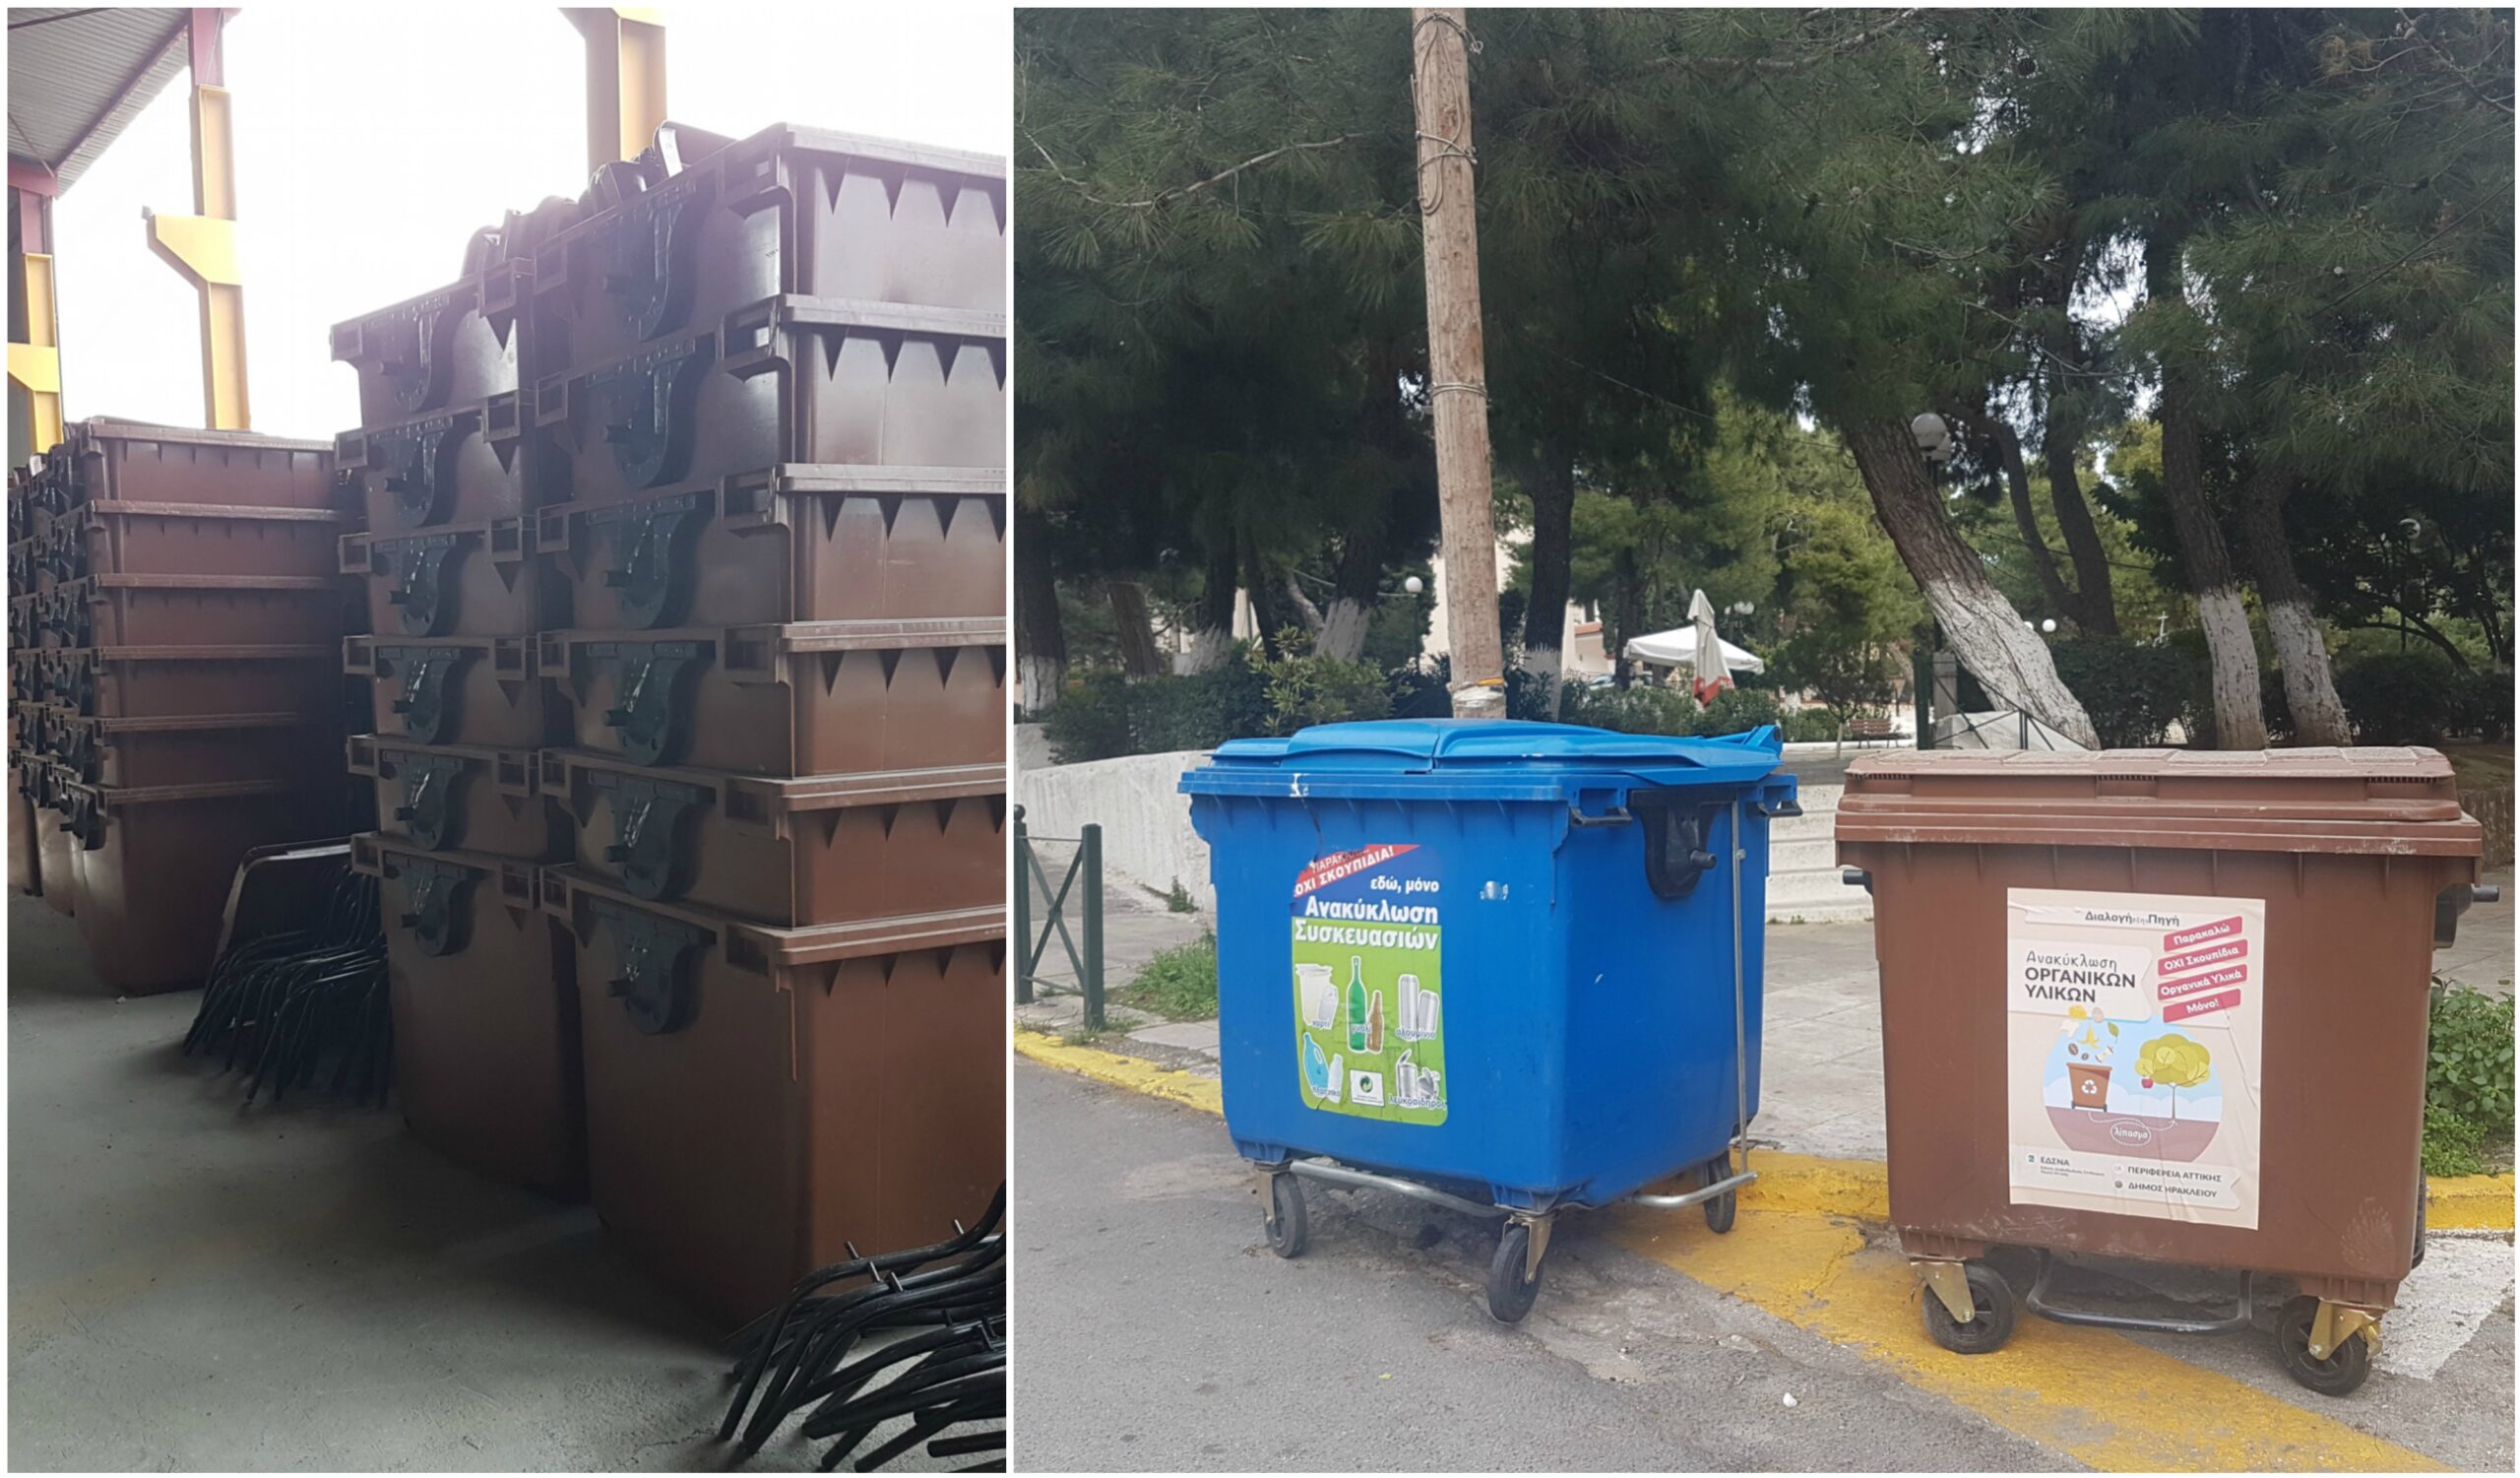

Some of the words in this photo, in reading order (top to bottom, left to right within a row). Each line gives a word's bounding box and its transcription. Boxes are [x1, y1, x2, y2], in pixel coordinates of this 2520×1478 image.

[1294, 877, 1316, 896] ΟΧΙ
[1319, 845, 1395, 885] ΣΚΟΥΠΙΔΙΑ!
[1370, 875, 1402, 893] εδώ,
[1406, 876, 1439, 894] μόνο
[1305, 895, 1438, 924] Ανακύκλωση
[2085, 910, 2132, 925] Διαλογή
[2148, 913, 2179, 927] Πηγή
[1294, 919, 1439, 950] Συσκευασιών
[2173, 923, 2231, 945] Παρακαλώ
[2026, 950, 2117, 973] Ανακύκλωση
[2164, 957, 2185, 971] ΟΧΙ
[2186, 946, 2239, 967] Σκουπίδια
[2025, 966, 2136, 988] ΟΡΓΑΝΙΚΩΝ
[2160, 977, 2210, 996] Οργανικά
[2211, 970, 2242, 984] Υλικά
[2025, 984, 2096, 1003] ΥΛΙΚΩΝ
[2185, 997, 2220, 1013] Μόνο!
[2113, 1126, 2148, 1140] λίπασμα
[2127, 1166, 2181, 1179] ΠΕΡΙΦΕΡΕΙΑ
[2182, 1170, 2223, 1183] ΑΤΤΙΚΗΣ
[2127, 1182, 2164, 1192] ΔΗΜΟΣ
[2165, 1186, 2218, 1198] ΗΡΑΚΛΕΙΟΥ
